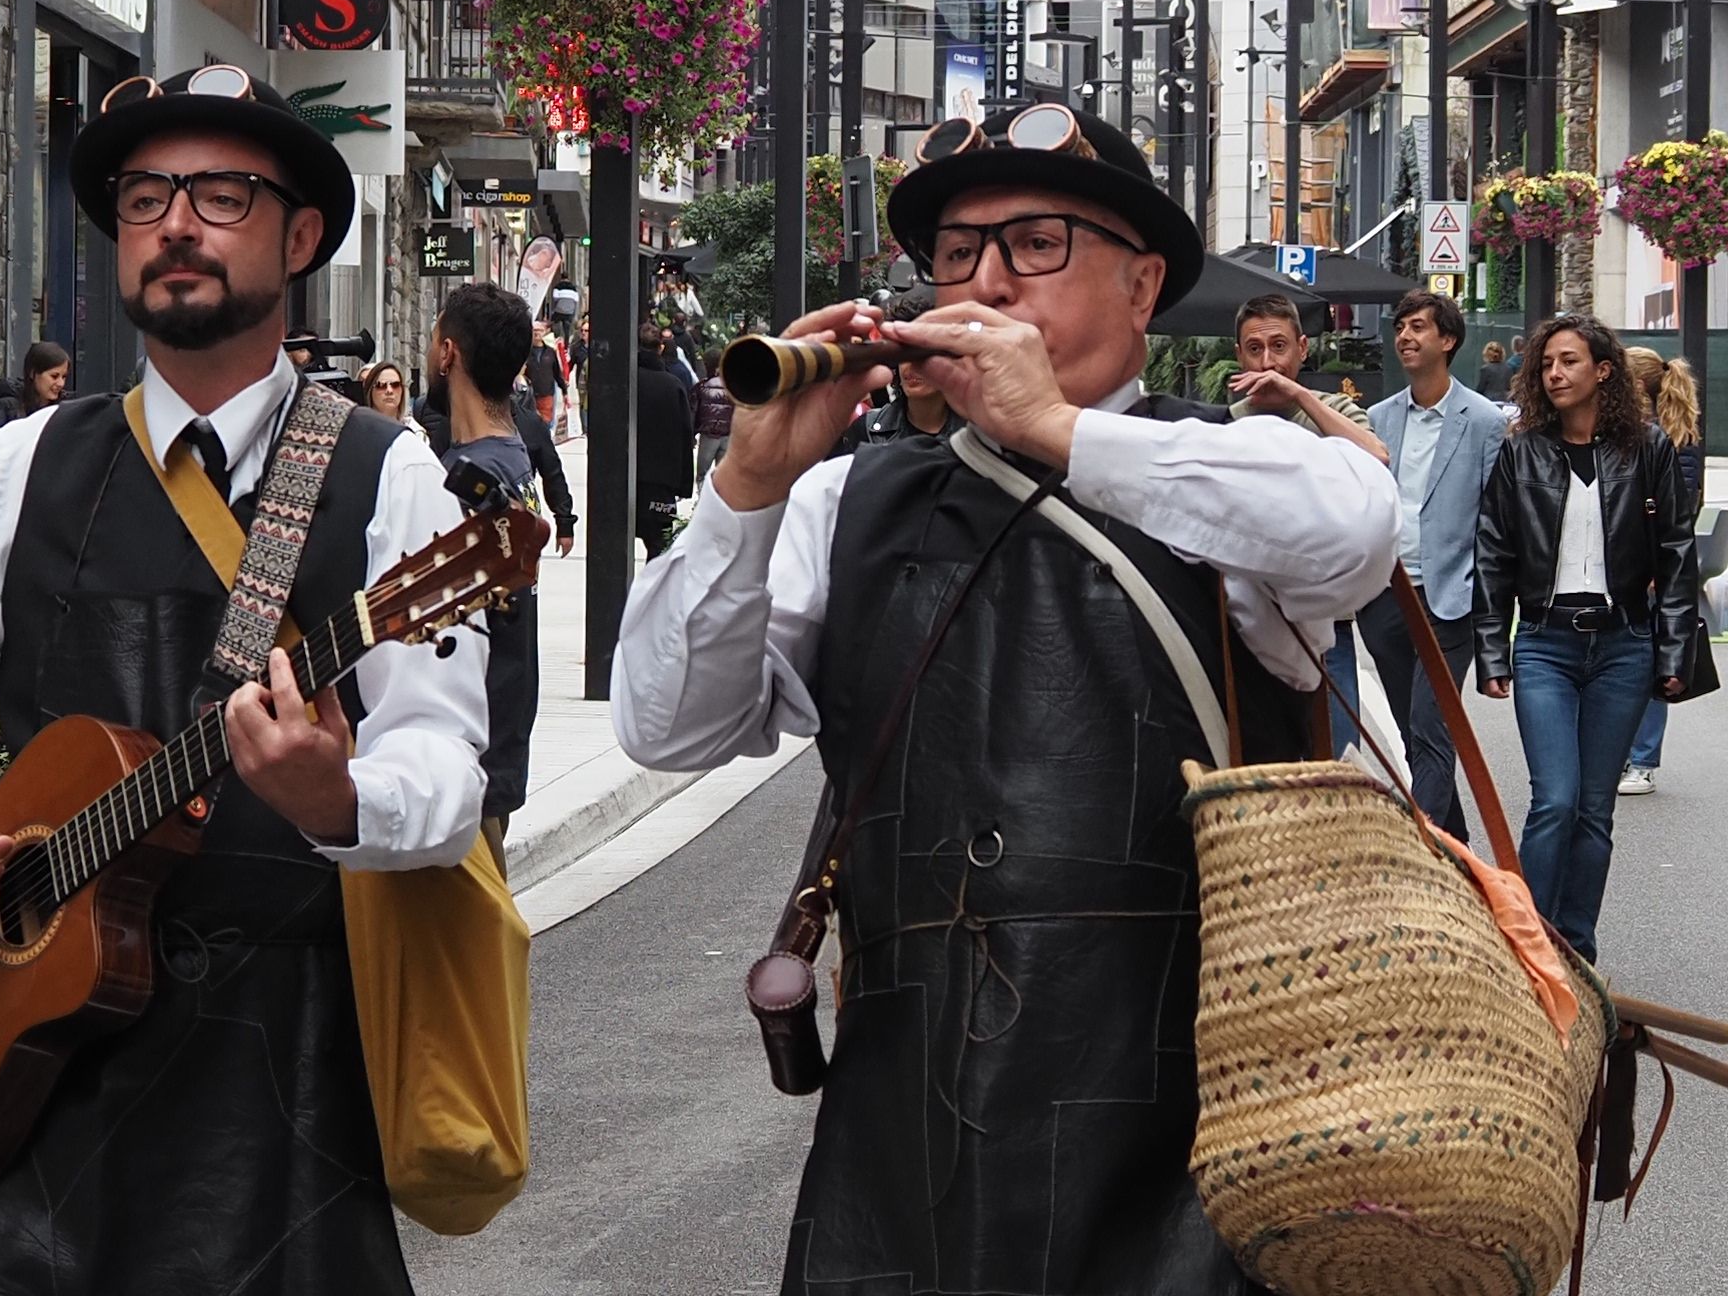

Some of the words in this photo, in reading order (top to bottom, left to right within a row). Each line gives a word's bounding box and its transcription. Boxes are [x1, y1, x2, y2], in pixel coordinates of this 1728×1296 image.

[1005, 39, 1018, 81] DEL
[424, 235, 448, 251] Jeff
[425, 253, 471, 272] Bruges
[1282, 247, 1306, 274] P
